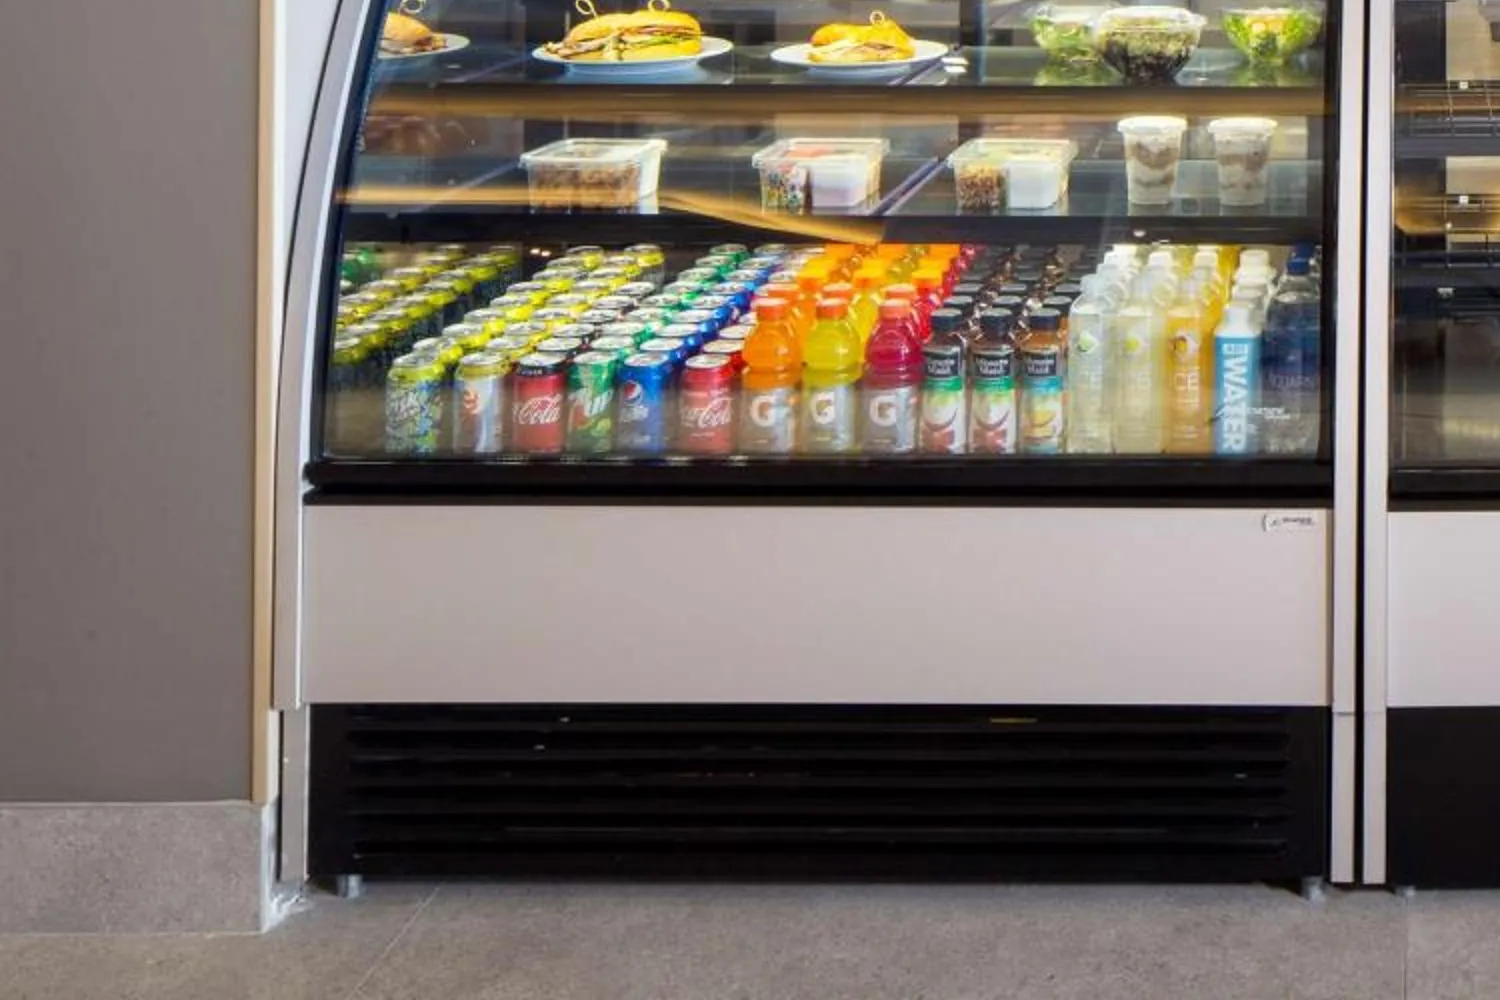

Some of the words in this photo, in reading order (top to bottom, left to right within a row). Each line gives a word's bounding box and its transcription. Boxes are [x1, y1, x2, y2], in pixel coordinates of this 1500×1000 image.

[751, 395, 776, 427] G
[811, 392, 835, 424] G
[870, 394, 898, 427] G
[1223, 356, 1248, 452] WATER
